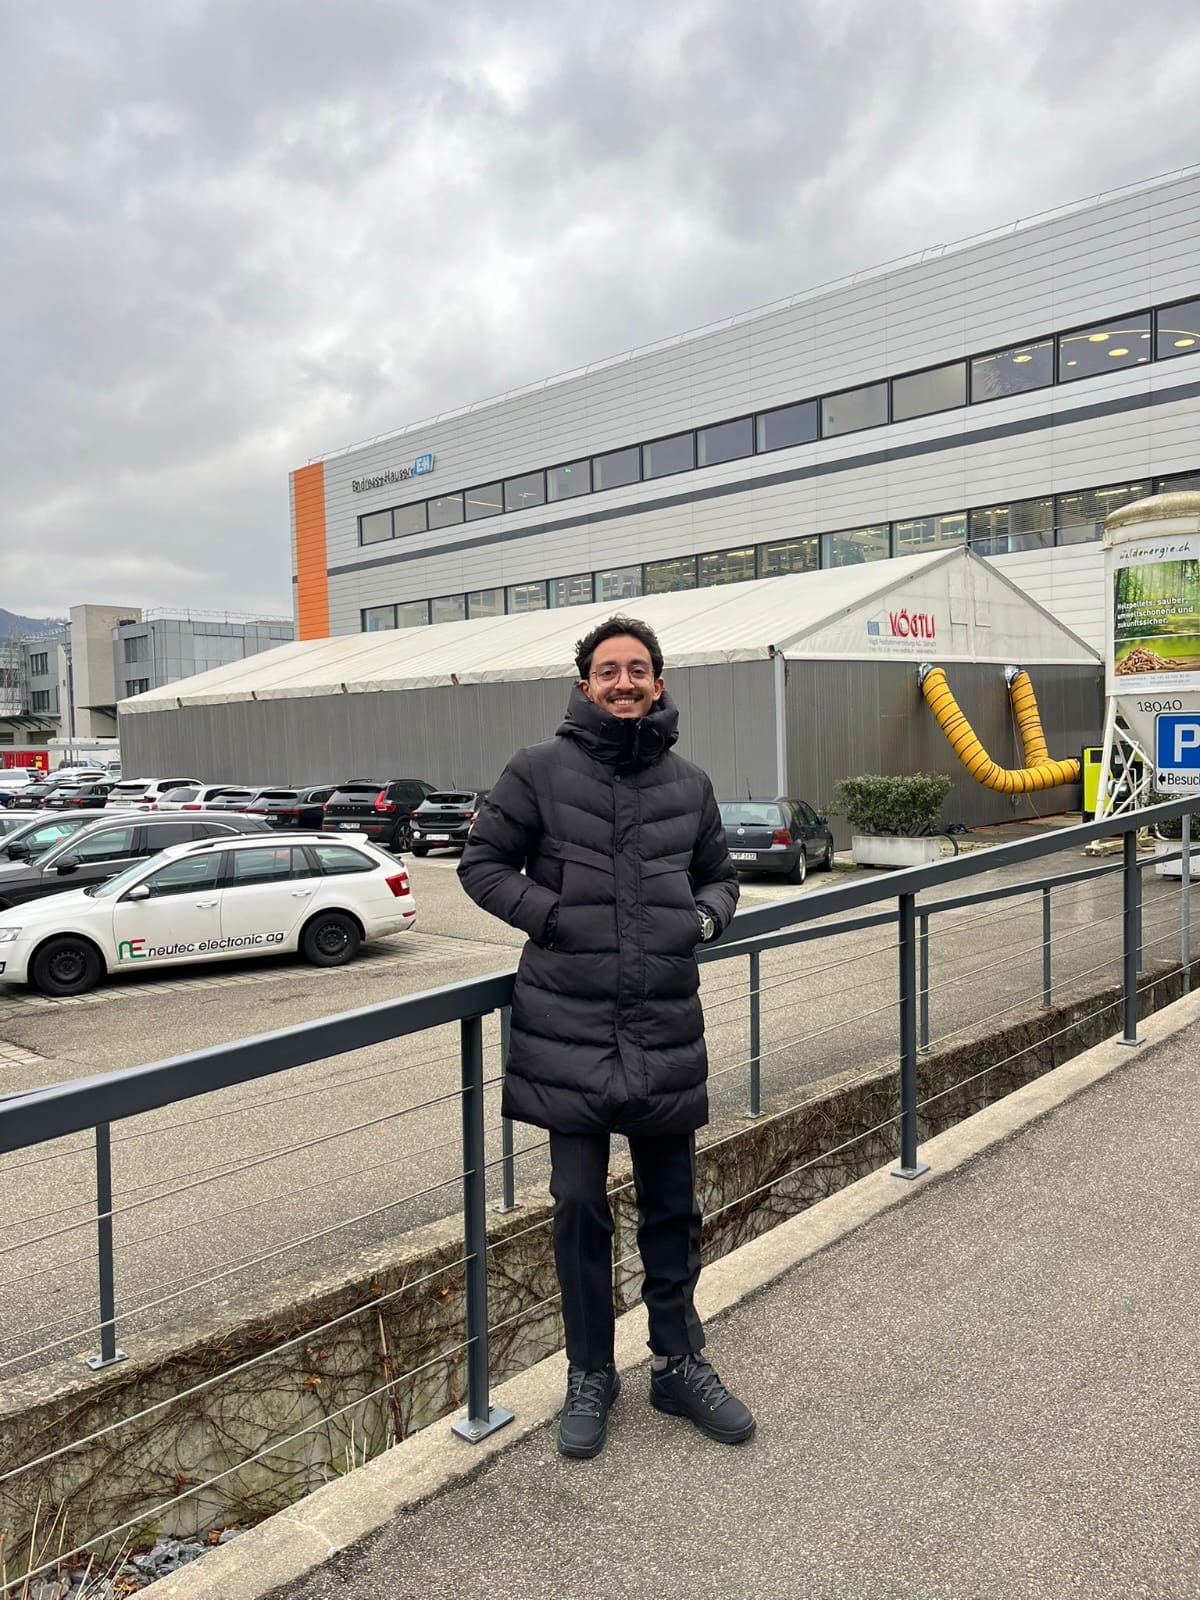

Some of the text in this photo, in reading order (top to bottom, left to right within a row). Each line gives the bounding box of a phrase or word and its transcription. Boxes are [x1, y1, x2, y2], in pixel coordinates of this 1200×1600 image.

[889, 608, 935, 638] VÖGTLI
[1137, 699, 1183, 712] 18040
[1174, 724, 1200, 762] P
[148, 942, 195, 957] neutec
[199, 934, 263, 951] electronic
[266, 932, 284, 944] ag
